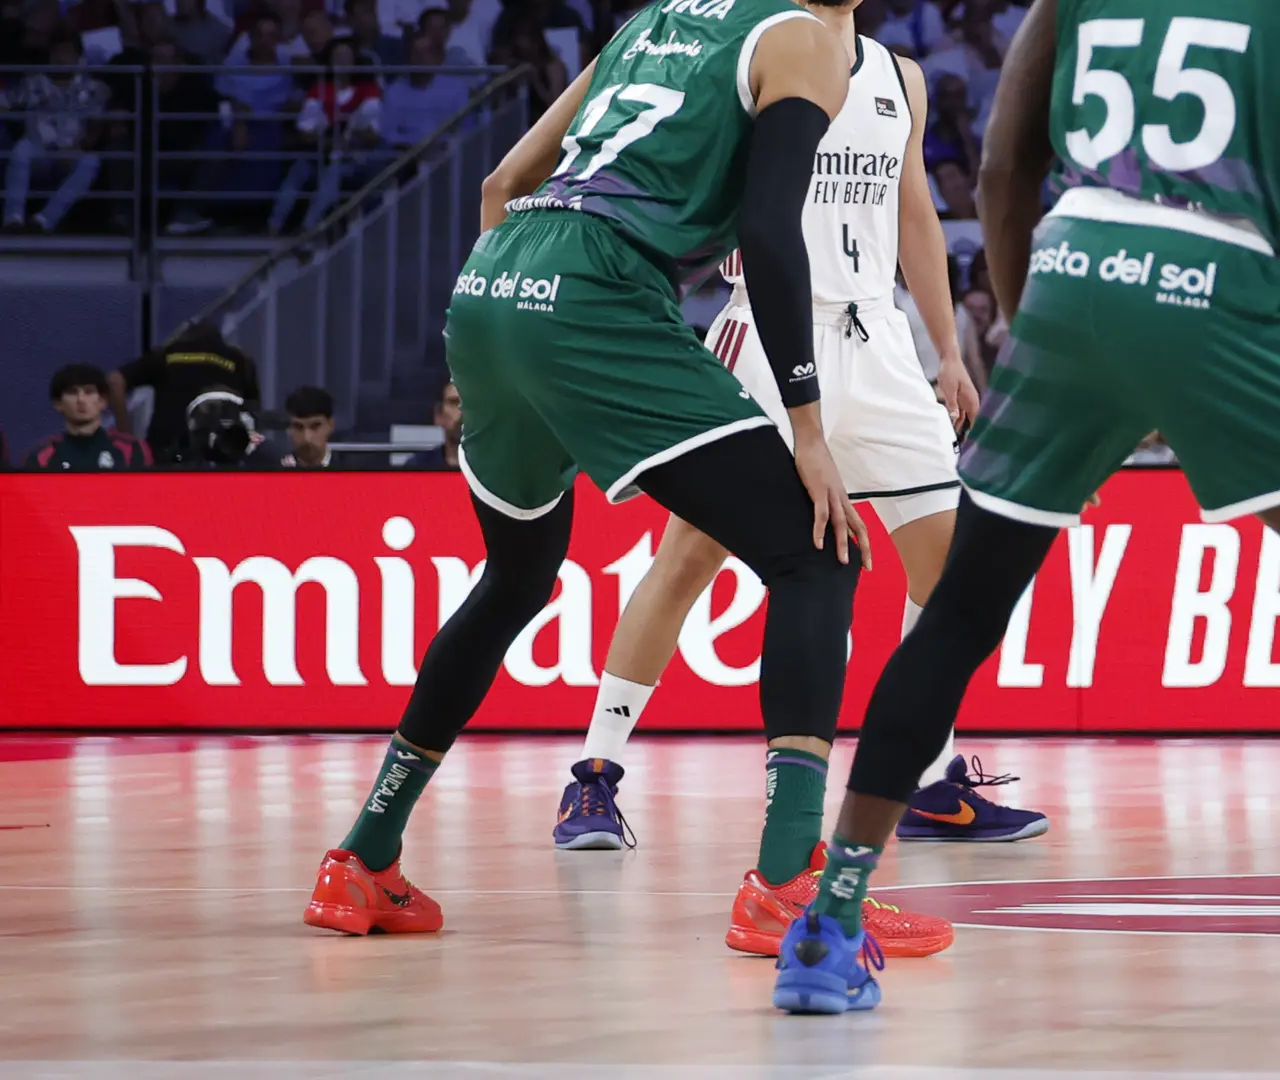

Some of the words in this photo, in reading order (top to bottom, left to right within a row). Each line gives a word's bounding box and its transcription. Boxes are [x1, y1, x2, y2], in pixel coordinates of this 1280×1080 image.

[1065, 16, 1251, 172] 55
[550, 82, 686, 181] 17
[813, 146, 899, 181] mirate
[813, 181, 839, 205] FLY
[842, 223, 860, 274] 4
[1031, 240, 1090, 278] osta
[1098, 248, 1154, 286] del
[1158, 261, 1217, 297] sol
[490, 271, 521, 299] del
[518, 273, 561, 302] sol
[996, 523, 1132, 688] LY
[367, 762, 412, 815] UNICAJA
